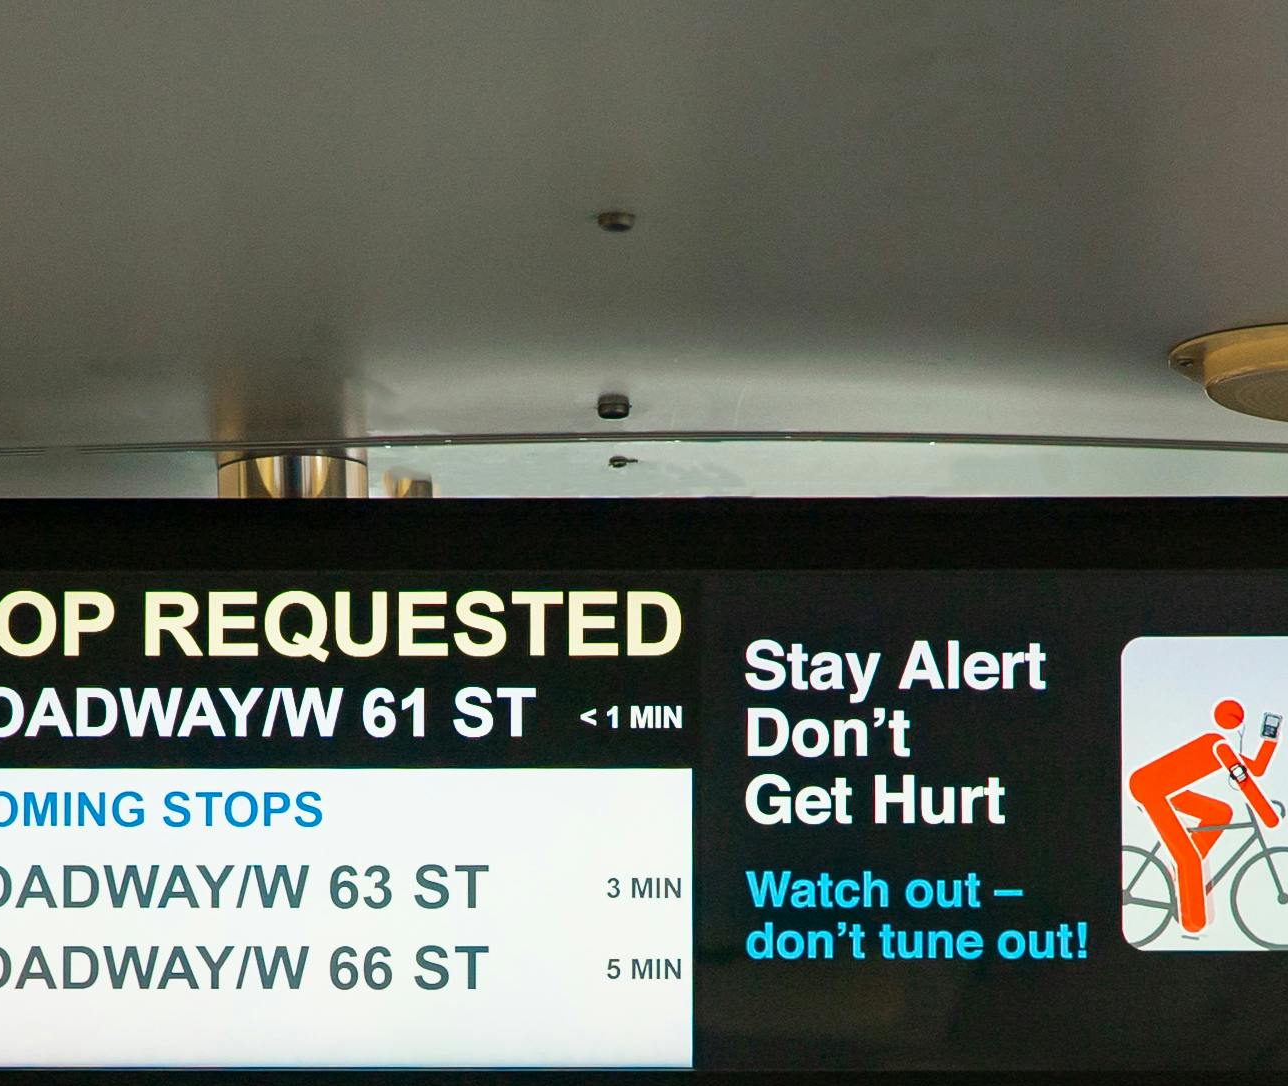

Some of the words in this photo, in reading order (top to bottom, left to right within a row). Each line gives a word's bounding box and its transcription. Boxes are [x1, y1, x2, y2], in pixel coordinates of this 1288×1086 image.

[144, 589, 683, 663] REQUESTED
[743, 637, 882, 704] Stay
[897, 638, 1047, 691] Alert
[362, 687, 425, 739] 61
[452, 686, 537, 738] ST
[606, 705, 619, 729] 1
[629, 705, 683, 729] MIN
[745, 706, 911, 759] Don’t
[162, 790, 323, 828] STOPS
[743, 772, 853, 826] Get
[873, 773, 1006, 826] Hurt
[329, 864, 393, 910] 63
[414, 863, 490, 910] ST
[606, 877, 621, 899] 3
[631, 877, 682, 899] MIN
[744, 870, 890, 910] Watch
[904, 871, 982, 909] out
[745, 921, 866, 960] don’t
[878, 923, 985, 961] tune
[996, 921, 1088, 960] out!
[329, 945, 393, 991] 66
[414, 944, 490, 991] ST
[606, 958, 621, 980] 5
[631, 958, 682, 980] MIN
